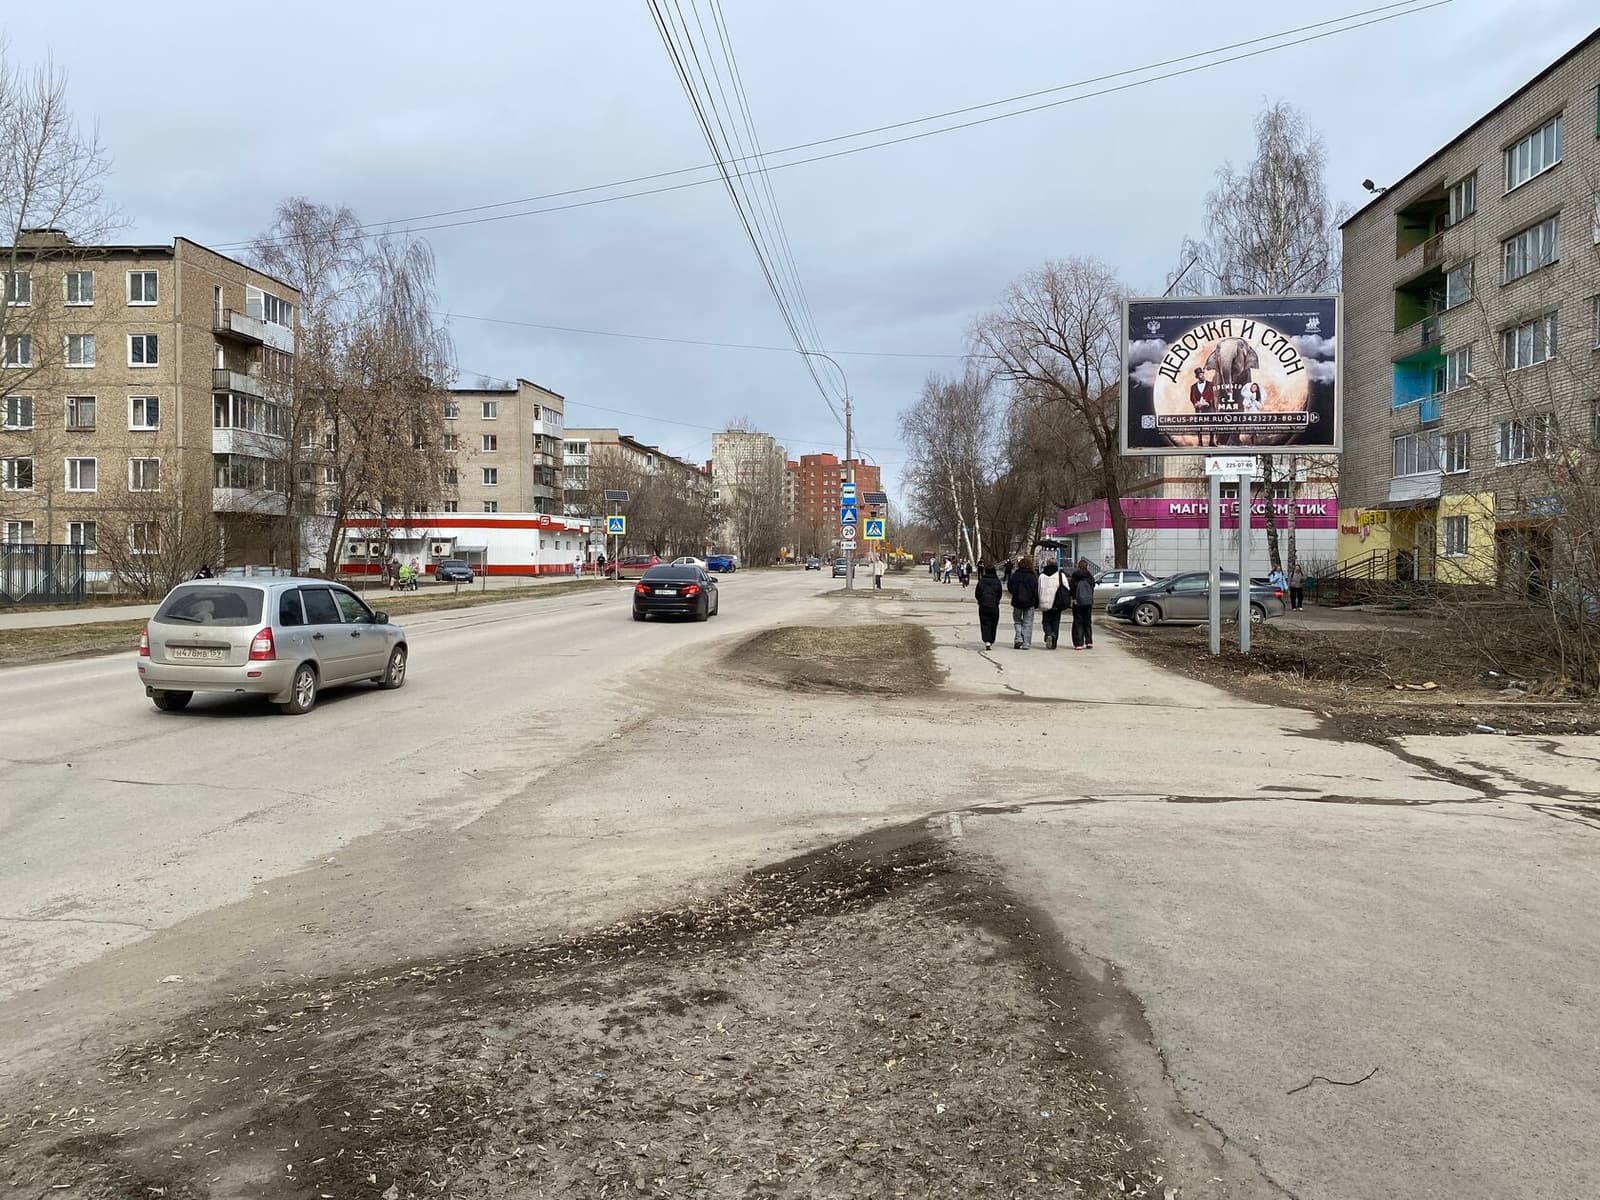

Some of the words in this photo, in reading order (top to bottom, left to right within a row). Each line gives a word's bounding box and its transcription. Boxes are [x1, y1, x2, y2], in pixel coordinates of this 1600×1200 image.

[1158, 319, 1233, 384] ДЕВОЧКА
[1240, 319, 1256, 340] И
[1261, 328, 1305, 376] СЛОН
[1227, 392, 1235, 403] 1
[1159, 415, 1223, 423] CIRCUS-PERM.RU
[1169, 503, 1229, 514] МАГНТ
[1249, 503, 1327, 514] КОМТИК
